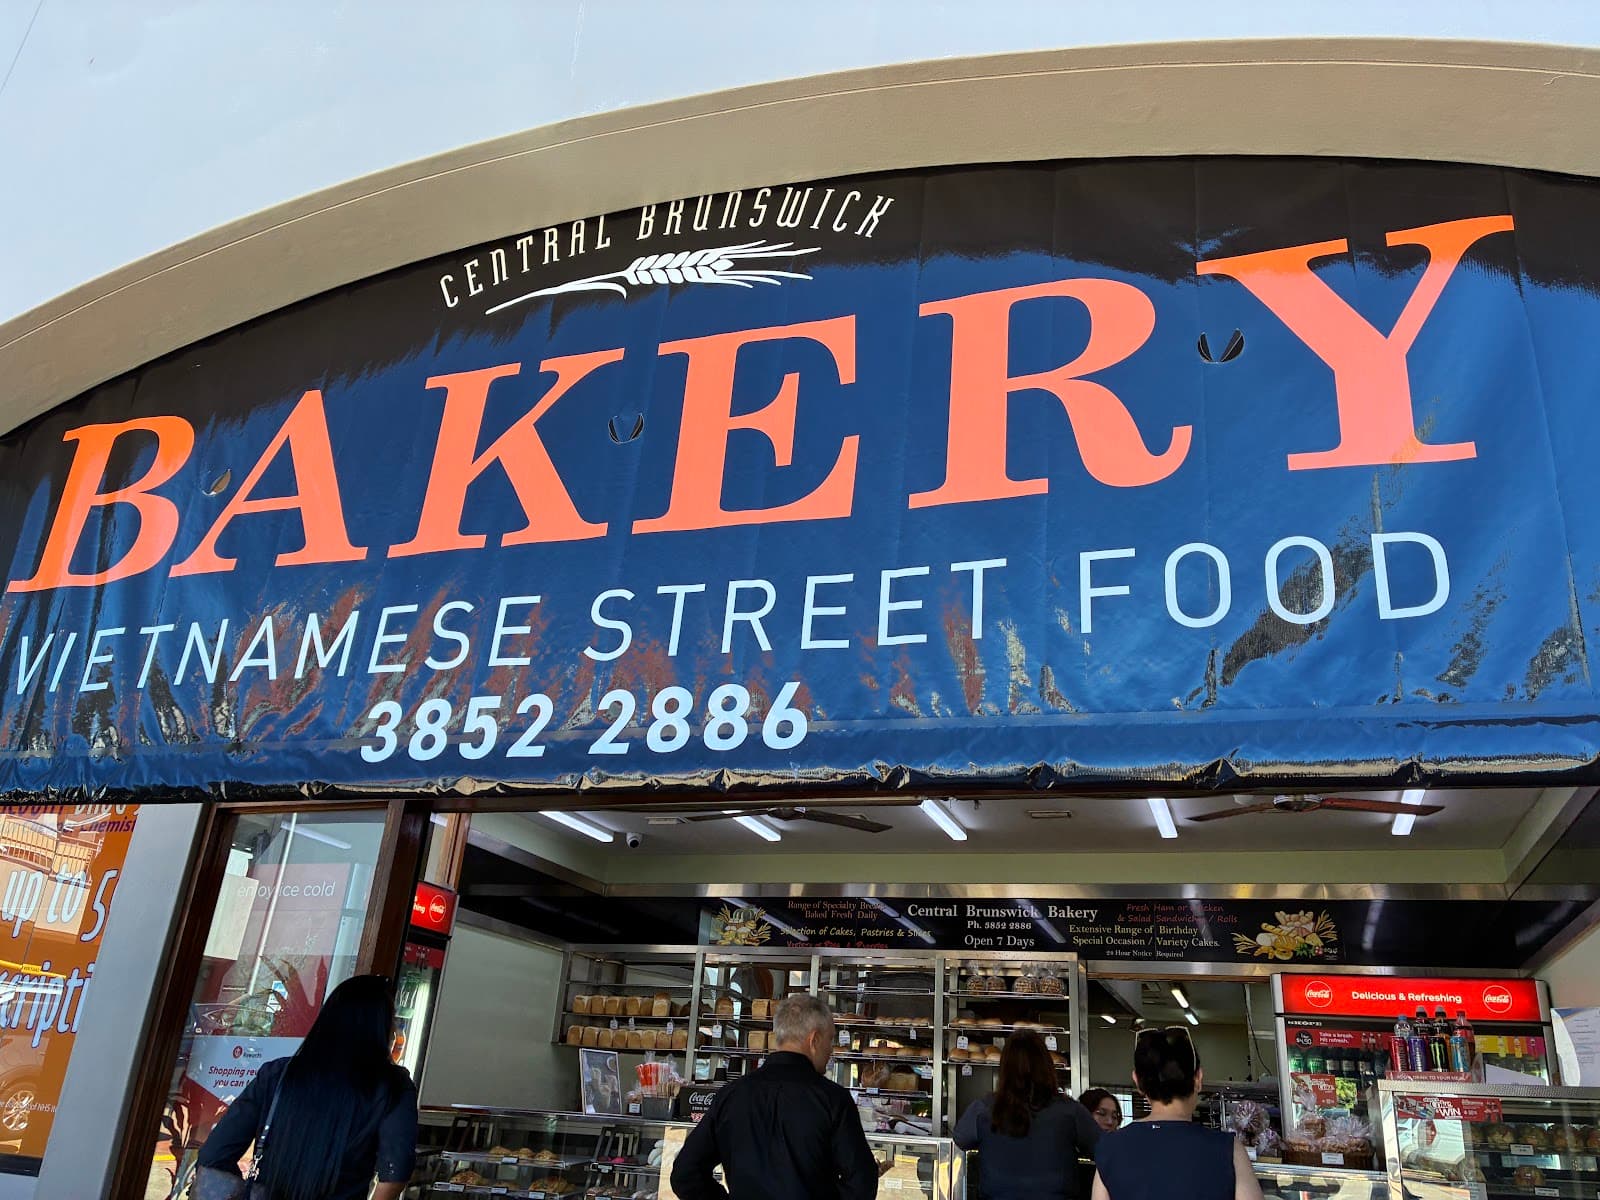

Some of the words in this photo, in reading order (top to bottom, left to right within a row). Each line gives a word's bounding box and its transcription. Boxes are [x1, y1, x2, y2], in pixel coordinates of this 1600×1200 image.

[438, 214, 612, 308] CENTRAL
[636, 186, 897, 242] BRUNSWICK
[7, 214, 1514, 593] BAKERY
[16, 596, 541, 695] VIETNAMESE
[584, 557, 1008, 661] STREET
[1079, 531, 1450, 634] FOOD
[359, 695, 556, 763] 3852
[588, 681, 810, 756] 2886
[81, 817, 138, 832] hemist
[239, 881, 275, 900] enoy
[279, 882, 299, 897] ice
[304, 880, 336, 897] cold
[1, 870, 43, 939] up
[45, 863, 86, 925] to
[788, 901, 812, 911] Range
[812, 900, 821, 909] of
[823, 900, 856, 912] Specialty
[805, 910, 827, 918] Baked
[831, 911, 853, 919] Fresh
[857, 911, 879, 921] Daily
[907, 904, 957, 917] Central
[966, 904, 1040, 918] Brunswick
[1048, 905, 1098, 922] Bakery
[1217, 915, 1238, 923] Rolls
[818, 926, 828, 936] of
[829, 928, 856, 937] Cakes,
[861, 928, 893, 937] Pastries
[896, 929, 904, 937] &
[967, 920, 982, 930] Ph.
[1069, 925, 1111, 934] Extensive
[1114, 926, 1142, 936] Range
[1144, 925, 1154, 935] of
[1160, 926, 1198, 937] Birthday
[965, 935, 993, 948] Open
[997, 935, 1004, 946] 7
[1007, 935, 1034, 949] Days
[1073, 936, 1103, 947] Special
[1105, 937, 1145, 945] Occasion
[1156, 937, 1189, 948] Variety
[1352, 991, 1397, 1002] Delicious
[1399, 992, 1406, 1001] &
[1408, 992, 1461, 1004] Refreshing
[208, 1066, 245, 1078] Shopping
[213, 1080, 228, 1089] you
[230, 1080, 244, 1088] can
